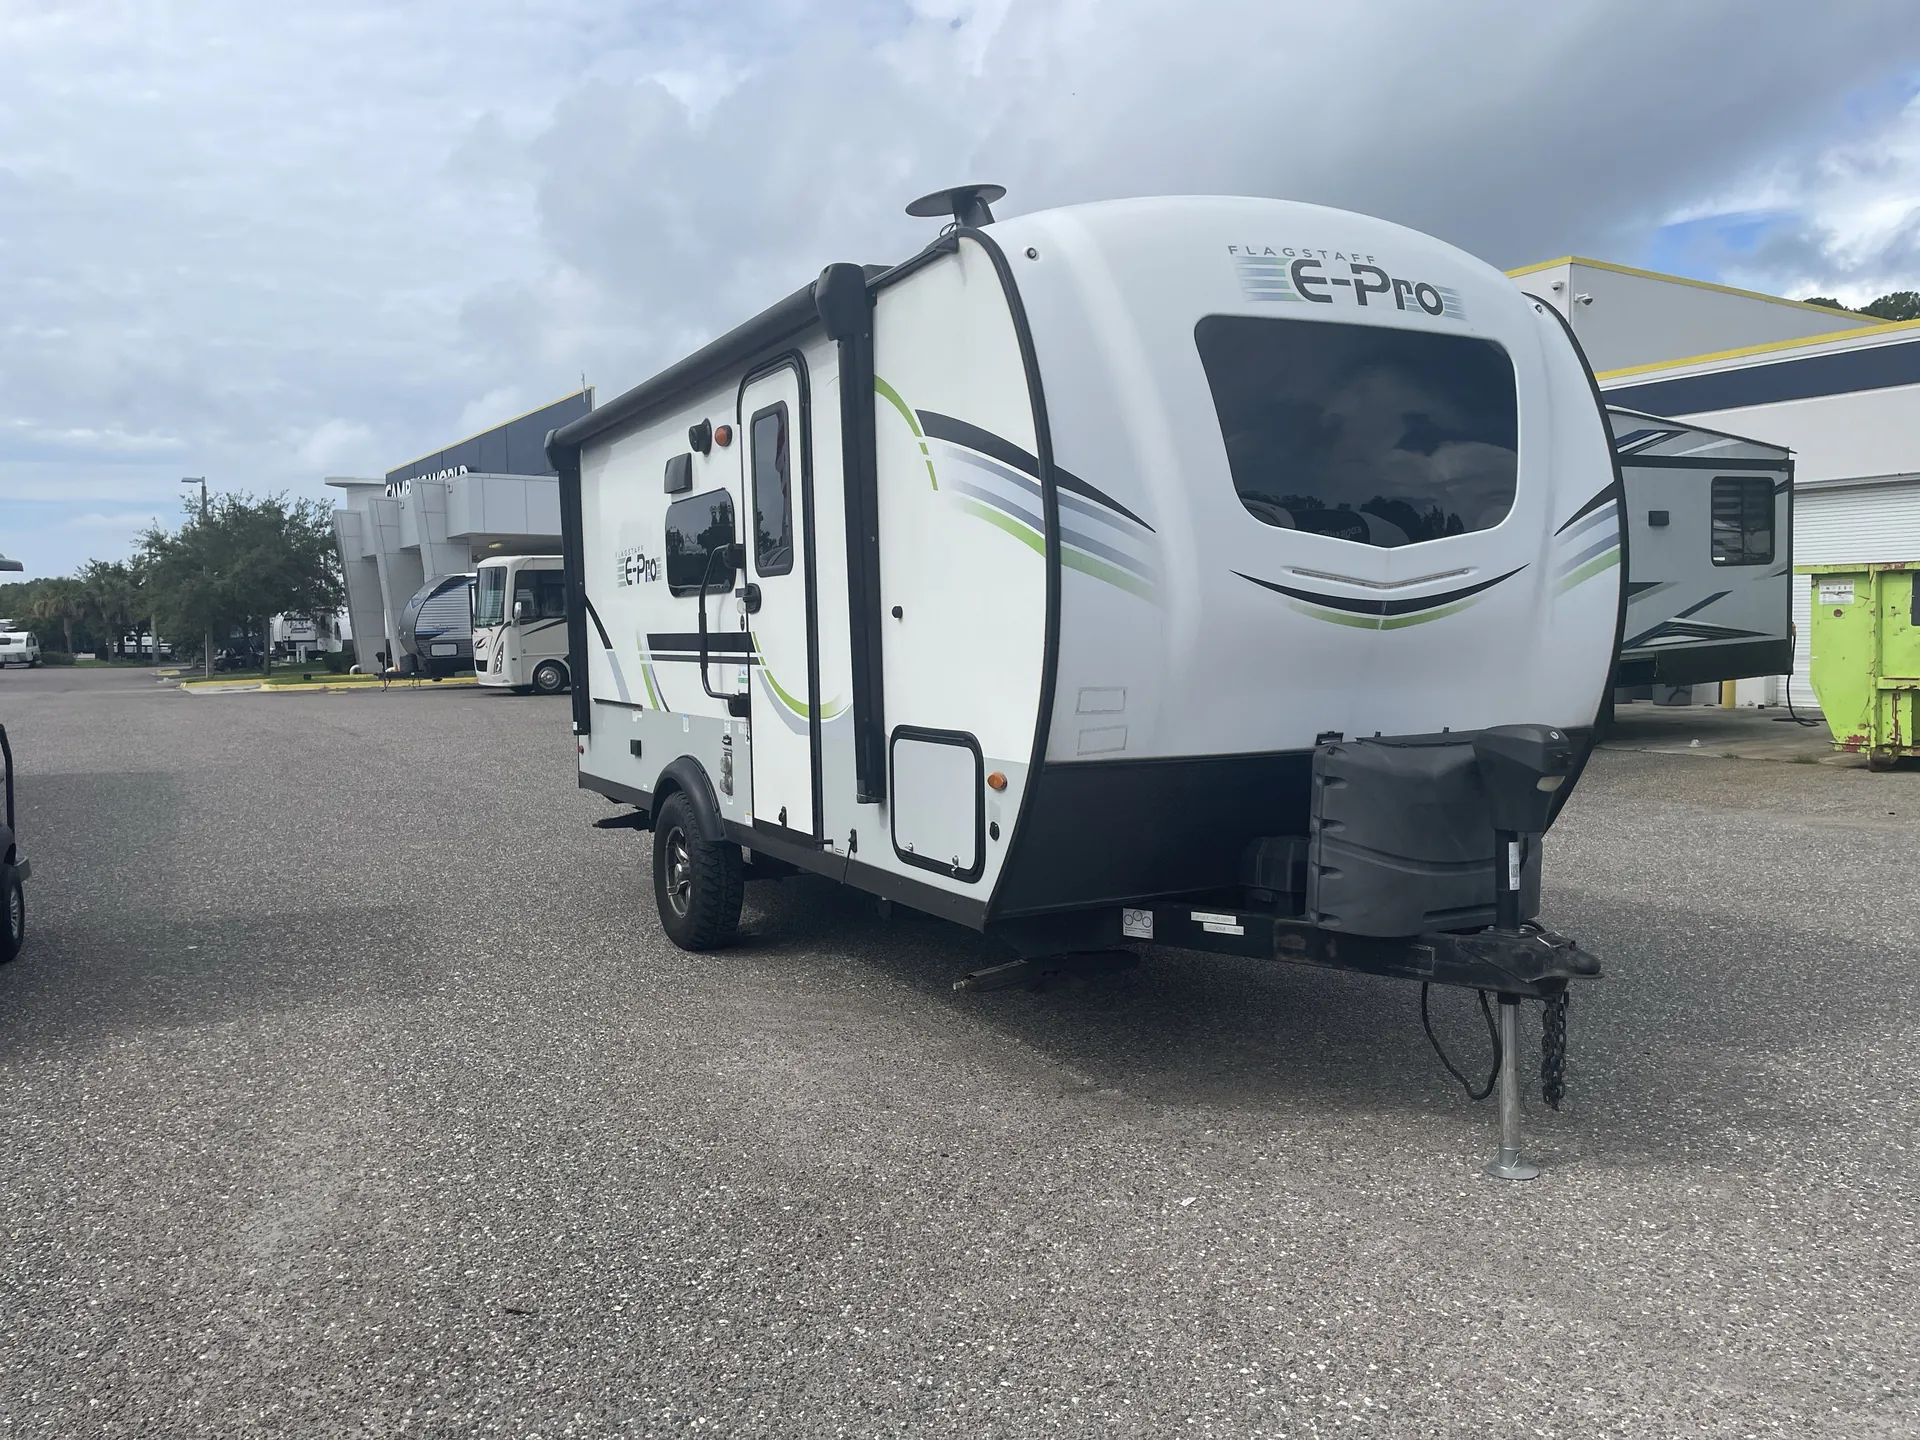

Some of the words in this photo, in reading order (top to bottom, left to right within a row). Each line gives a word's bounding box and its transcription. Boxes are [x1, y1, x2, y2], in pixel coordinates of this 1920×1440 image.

[1228, 245, 1375, 264] FLAGSTAFF
[1291, 258, 1444, 316] E-Pro
[385, 474, 427, 498] CAMP
[625, 553, 657, 586] E-Pro
